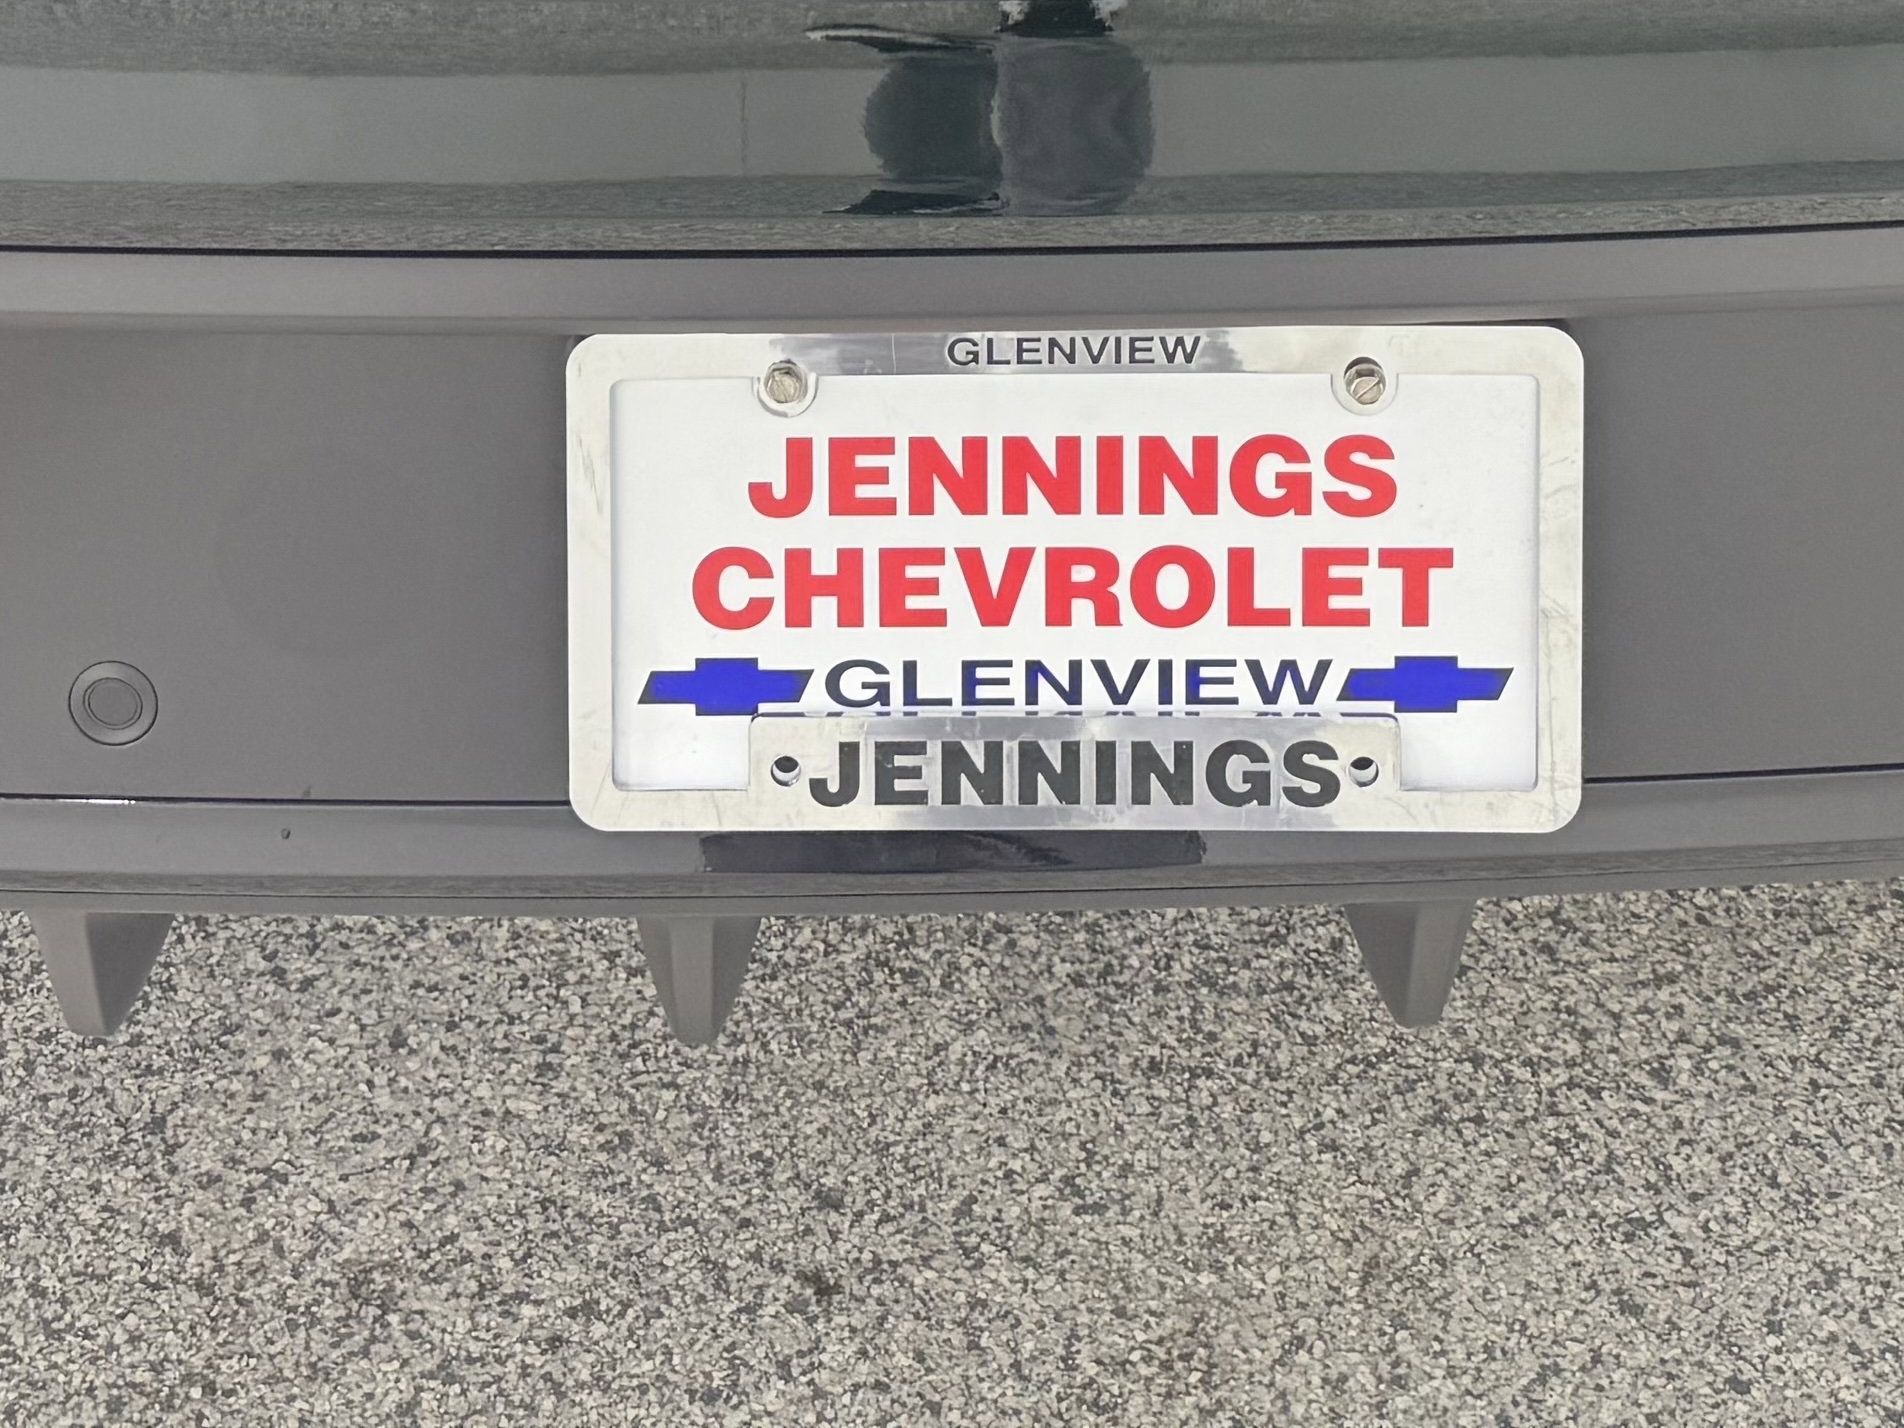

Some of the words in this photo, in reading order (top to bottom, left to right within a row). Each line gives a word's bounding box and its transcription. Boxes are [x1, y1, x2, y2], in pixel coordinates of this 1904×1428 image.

[947, 335, 1201, 366] GLENVIEW
[748, 434, 1398, 519] JENNINGS
[693, 545, 1453, 630] CHEVROLET
[824, 658, 1333, 707] GLENVIEW
[809, 740, 1341, 808] JENNINGS
